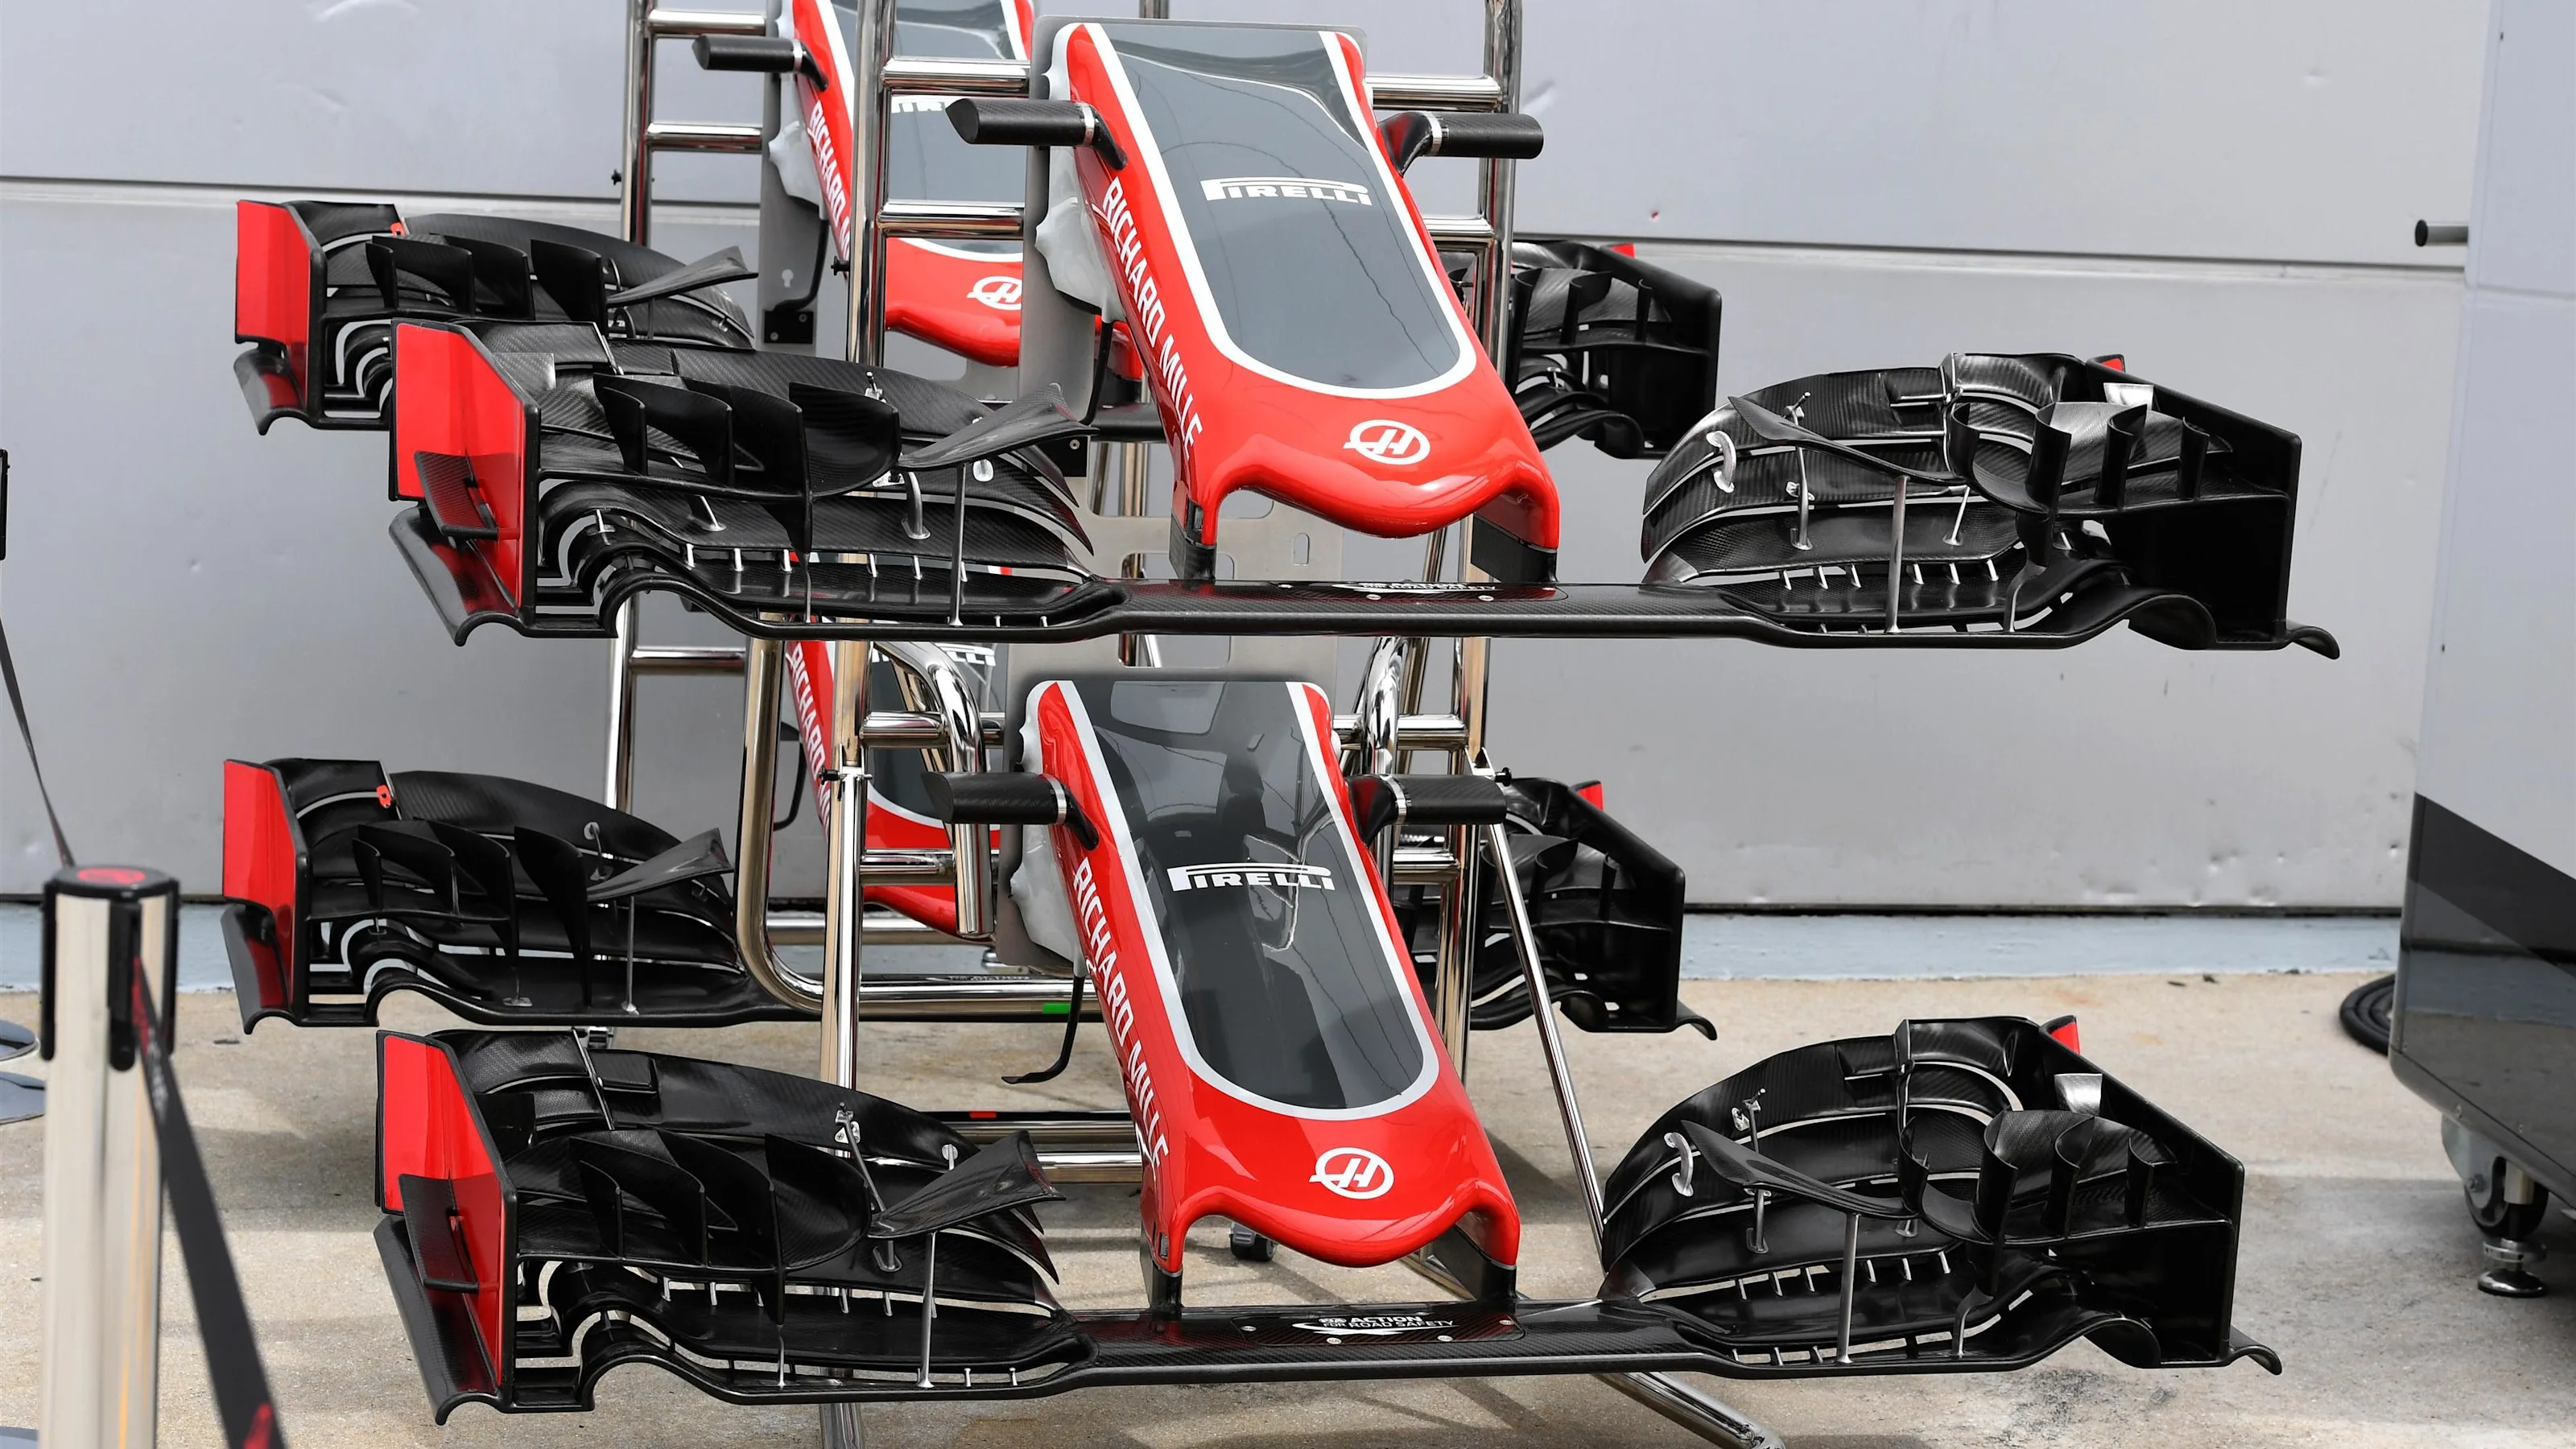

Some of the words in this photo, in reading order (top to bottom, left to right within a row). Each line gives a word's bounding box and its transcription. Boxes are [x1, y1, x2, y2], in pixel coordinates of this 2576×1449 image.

[809, 99, 847, 228] RICHARD
[1200, 176, 1373, 206] PIRELLI
[1103, 176, 1166, 348] RICHARD
[1159, 333, 1203, 461] MILLE
[872, 643, 997, 667] ILLI
[791, 642, 826, 781] RICHARD
[1166, 862, 1335, 891] PIRELLI
[1073, 857, 1134, 1047] RICHARD
[1127, 1038, 1170, 1168] MILLE
[1351, 1315, 1423, 1323] ACTION
